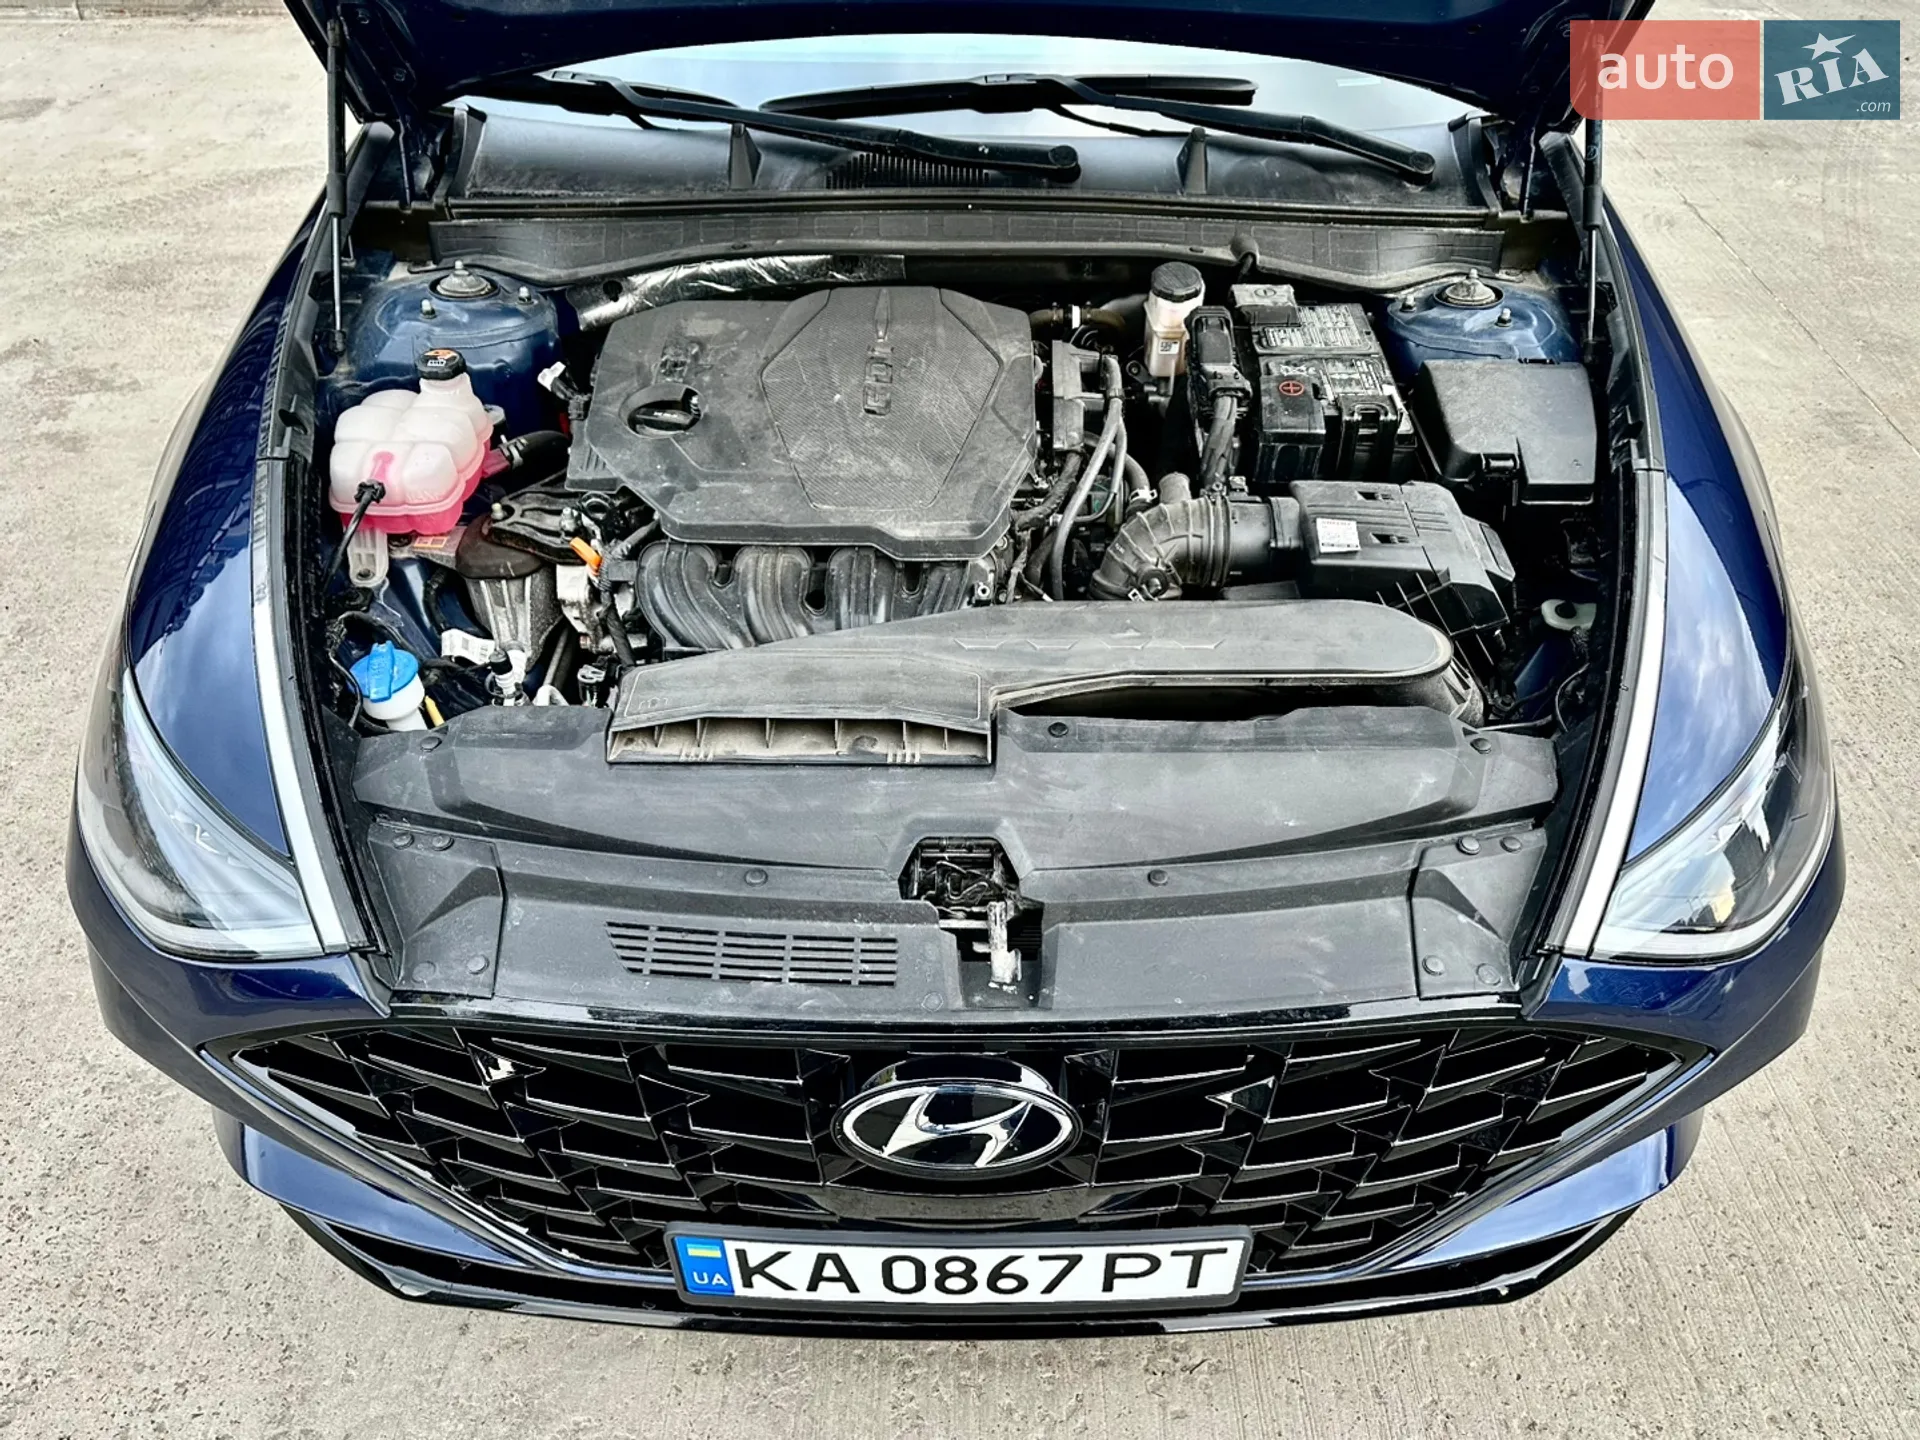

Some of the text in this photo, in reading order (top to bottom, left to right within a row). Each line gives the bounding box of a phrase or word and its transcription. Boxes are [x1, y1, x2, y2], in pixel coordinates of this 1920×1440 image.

[693, 1271, 728, 1286] UA
[735, 1248, 1228, 1295] KA 0867 PT
